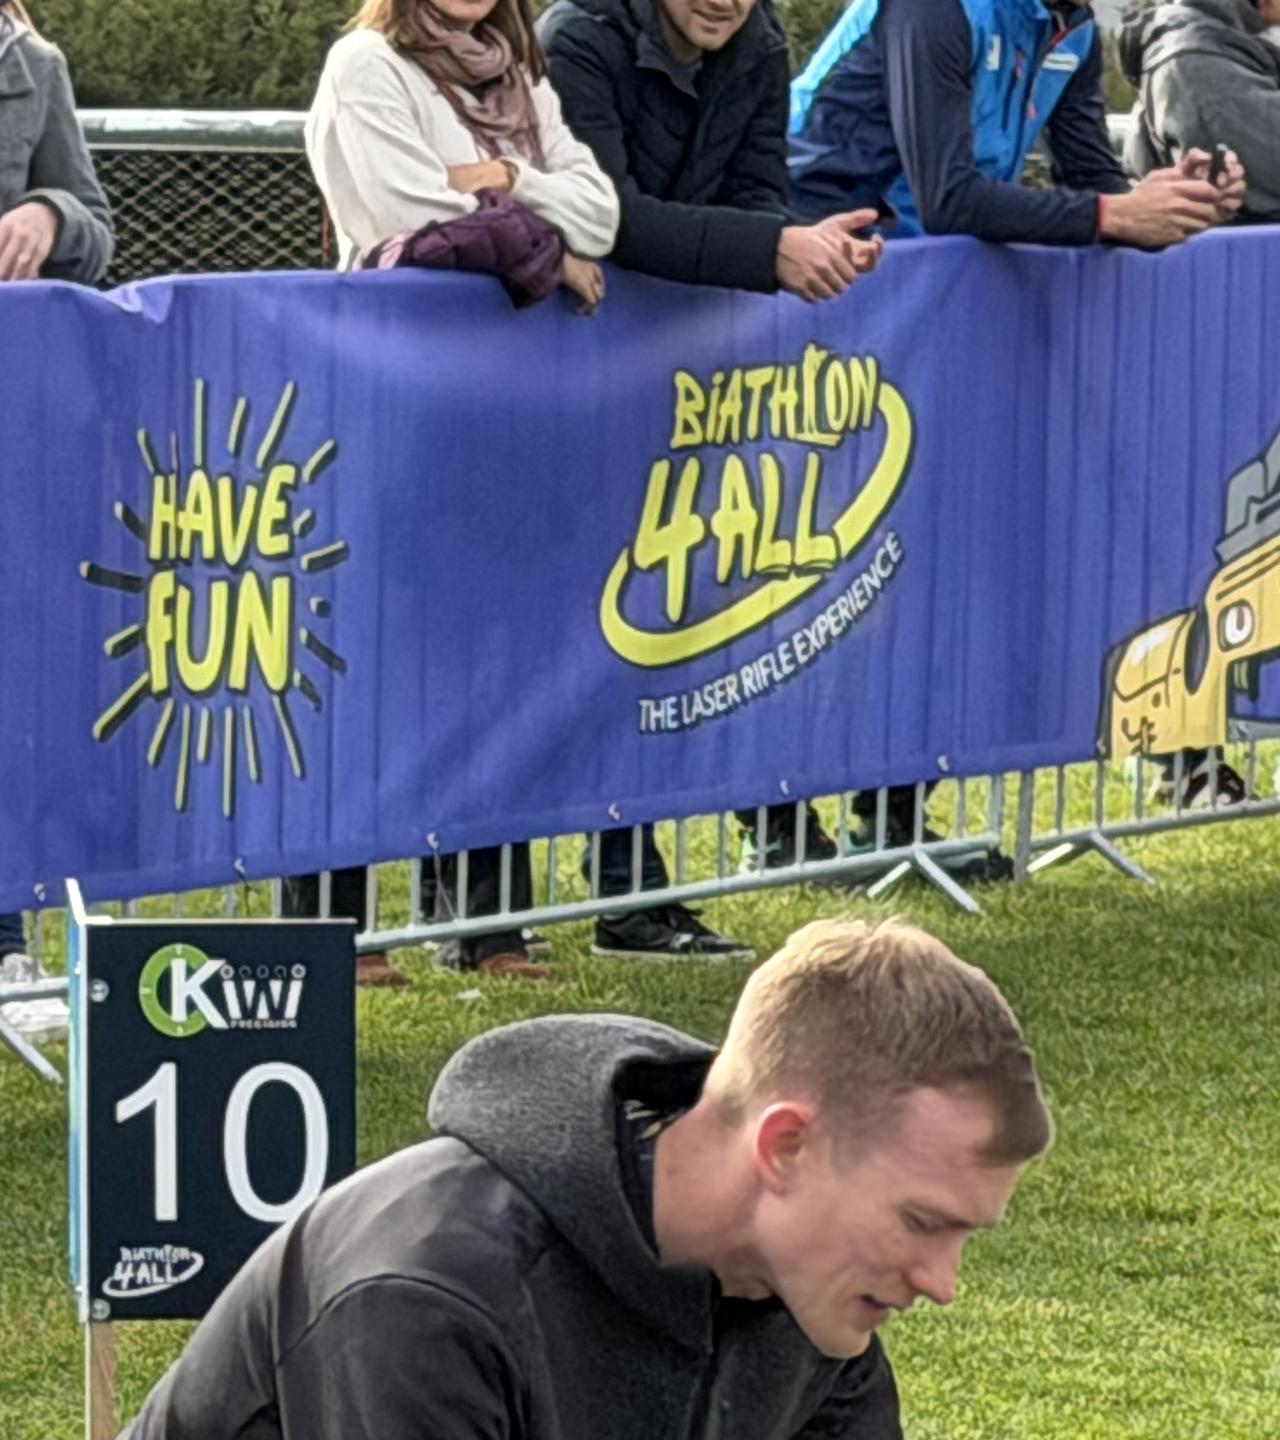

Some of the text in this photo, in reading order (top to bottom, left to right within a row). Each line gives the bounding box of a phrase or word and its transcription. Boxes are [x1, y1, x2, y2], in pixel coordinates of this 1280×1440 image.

[149, 464, 296, 566] HAVE
[634, 451, 837, 622] 4ALL
[147, 570, 290, 693] FUN
[639, 531, 903, 731] THE LASER RIFLE EXPERIENCE
[116, 1062, 329, 1223] 10
[114, 1261, 180, 1290] 4ALL
